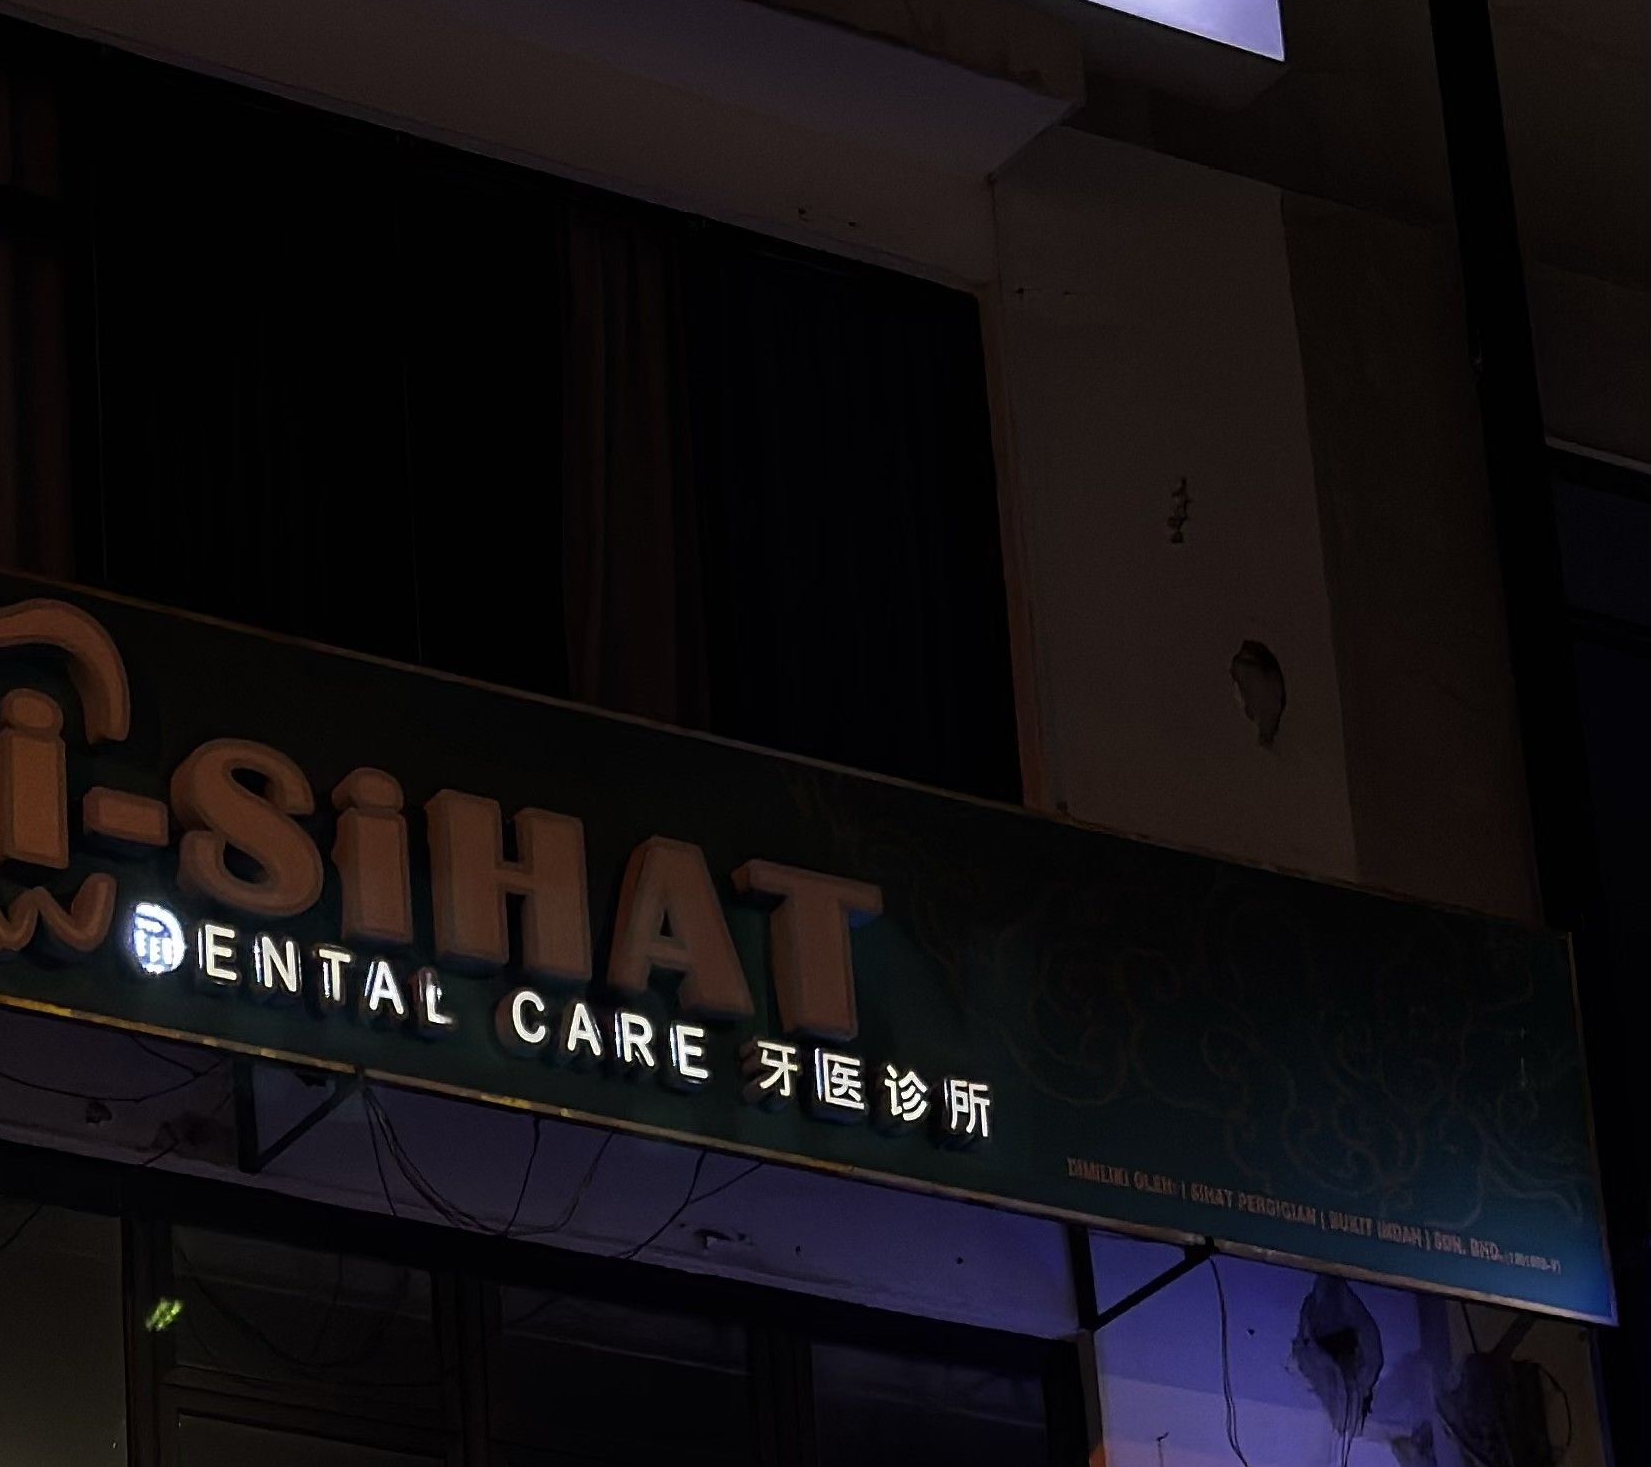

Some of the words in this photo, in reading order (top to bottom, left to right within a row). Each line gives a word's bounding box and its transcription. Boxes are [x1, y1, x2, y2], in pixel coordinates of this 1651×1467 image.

[127, 900, 454, 1030] DENTAL
[511, 987, 712, 1084] CARE
[756, 1036, 992, 1139] 牙医诊所
